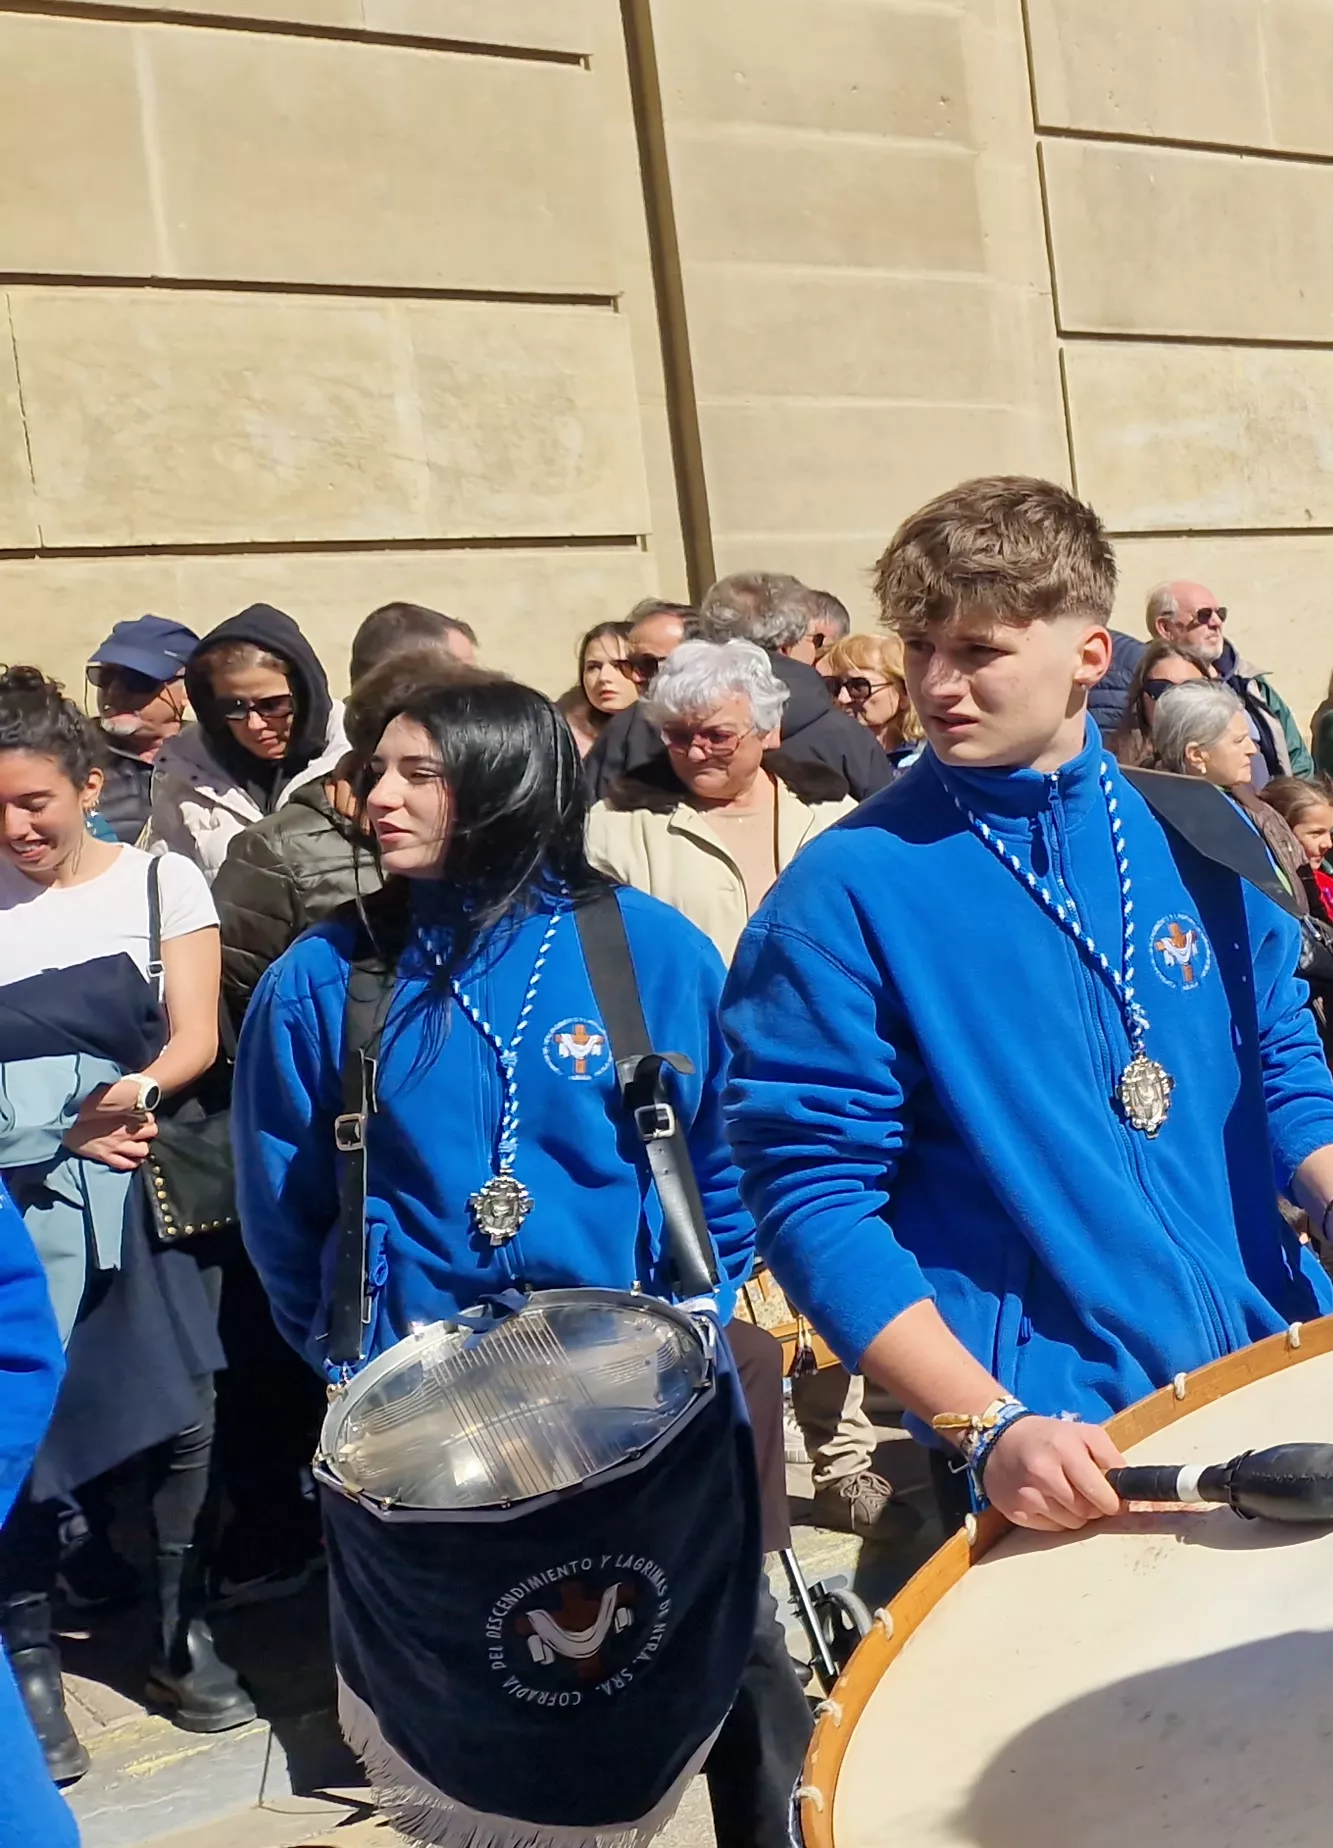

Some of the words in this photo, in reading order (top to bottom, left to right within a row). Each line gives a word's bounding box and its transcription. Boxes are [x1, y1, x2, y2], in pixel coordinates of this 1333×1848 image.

[600, 1554, 613, 1569] Y
[615, 1553, 669, 1598] LAGRIMAS
[486, 1558, 592, 1640] DESCENDIMIENTO
[488, 1646, 508, 1670] DEL
[632, 1622, 667, 1665] NTRA.
[502, 1674, 582, 1707] COFRADIA
[595, 1667, 634, 1696] SRA.
